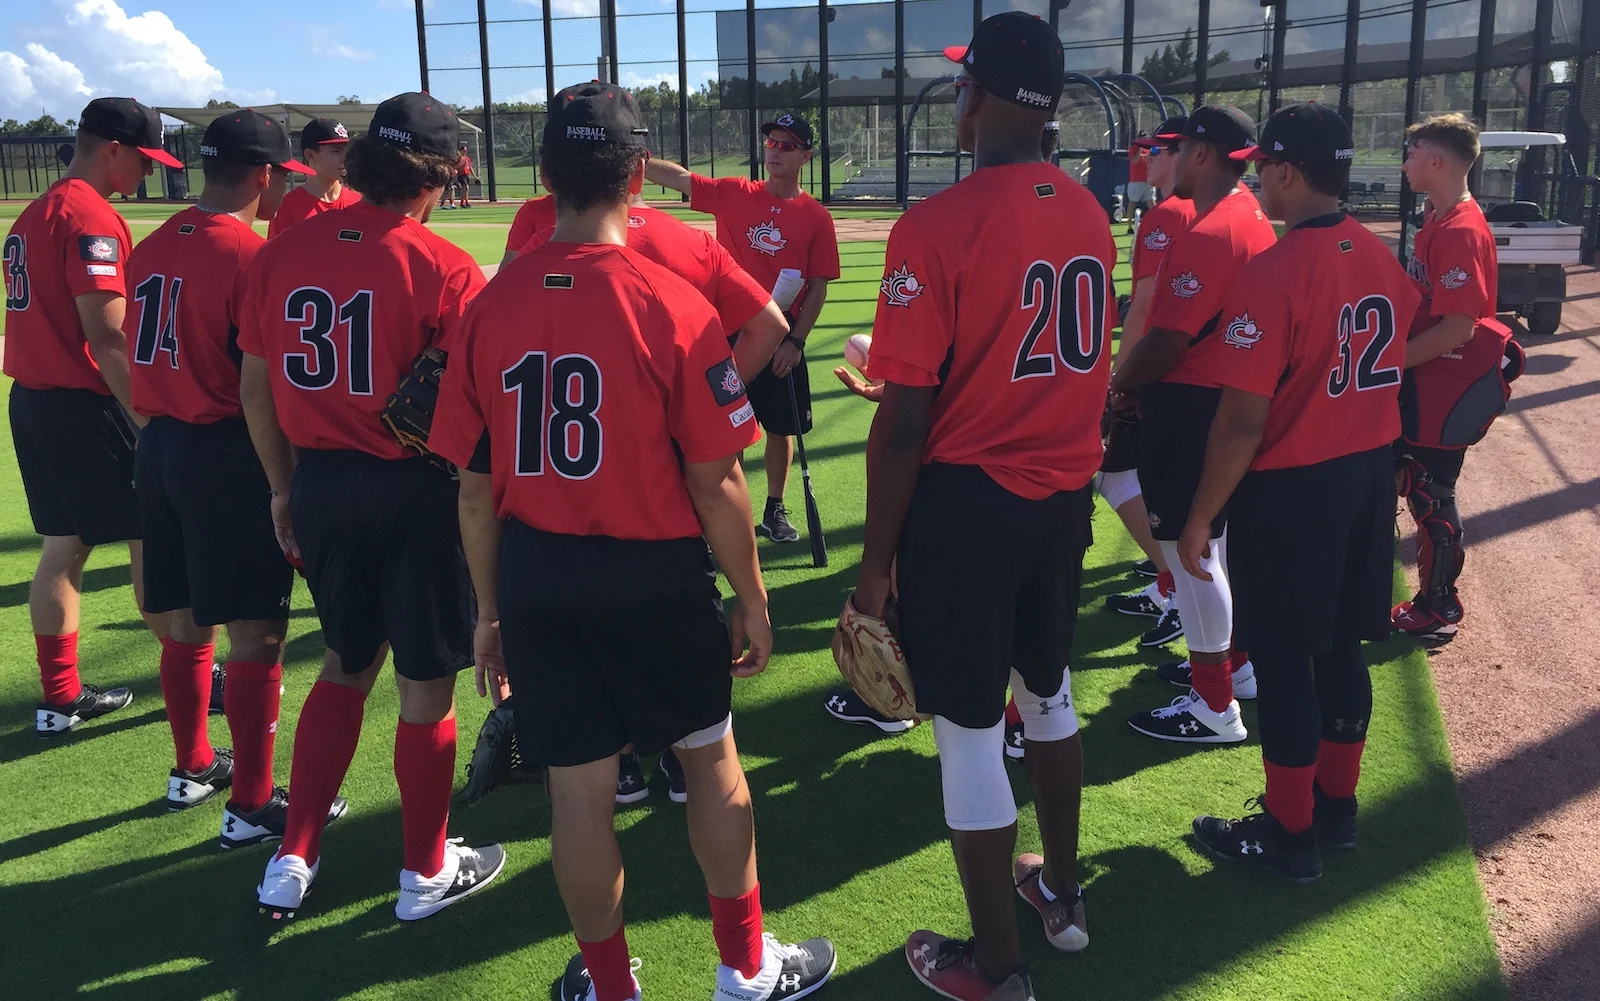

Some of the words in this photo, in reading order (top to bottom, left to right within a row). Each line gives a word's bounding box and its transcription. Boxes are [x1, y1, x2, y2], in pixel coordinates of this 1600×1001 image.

[379, 125, 412, 141] BASEBALL
[566, 126, 606, 137] BASEBALL
[1017, 87, 1052, 104] BASEBALL
[134, 273, 182, 370] 14
[283, 285, 374, 396] 31
[1010, 254, 1107, 383] 20
[1327, 293, 1401, 399] 32
[501, 350, 603, 480] 18
